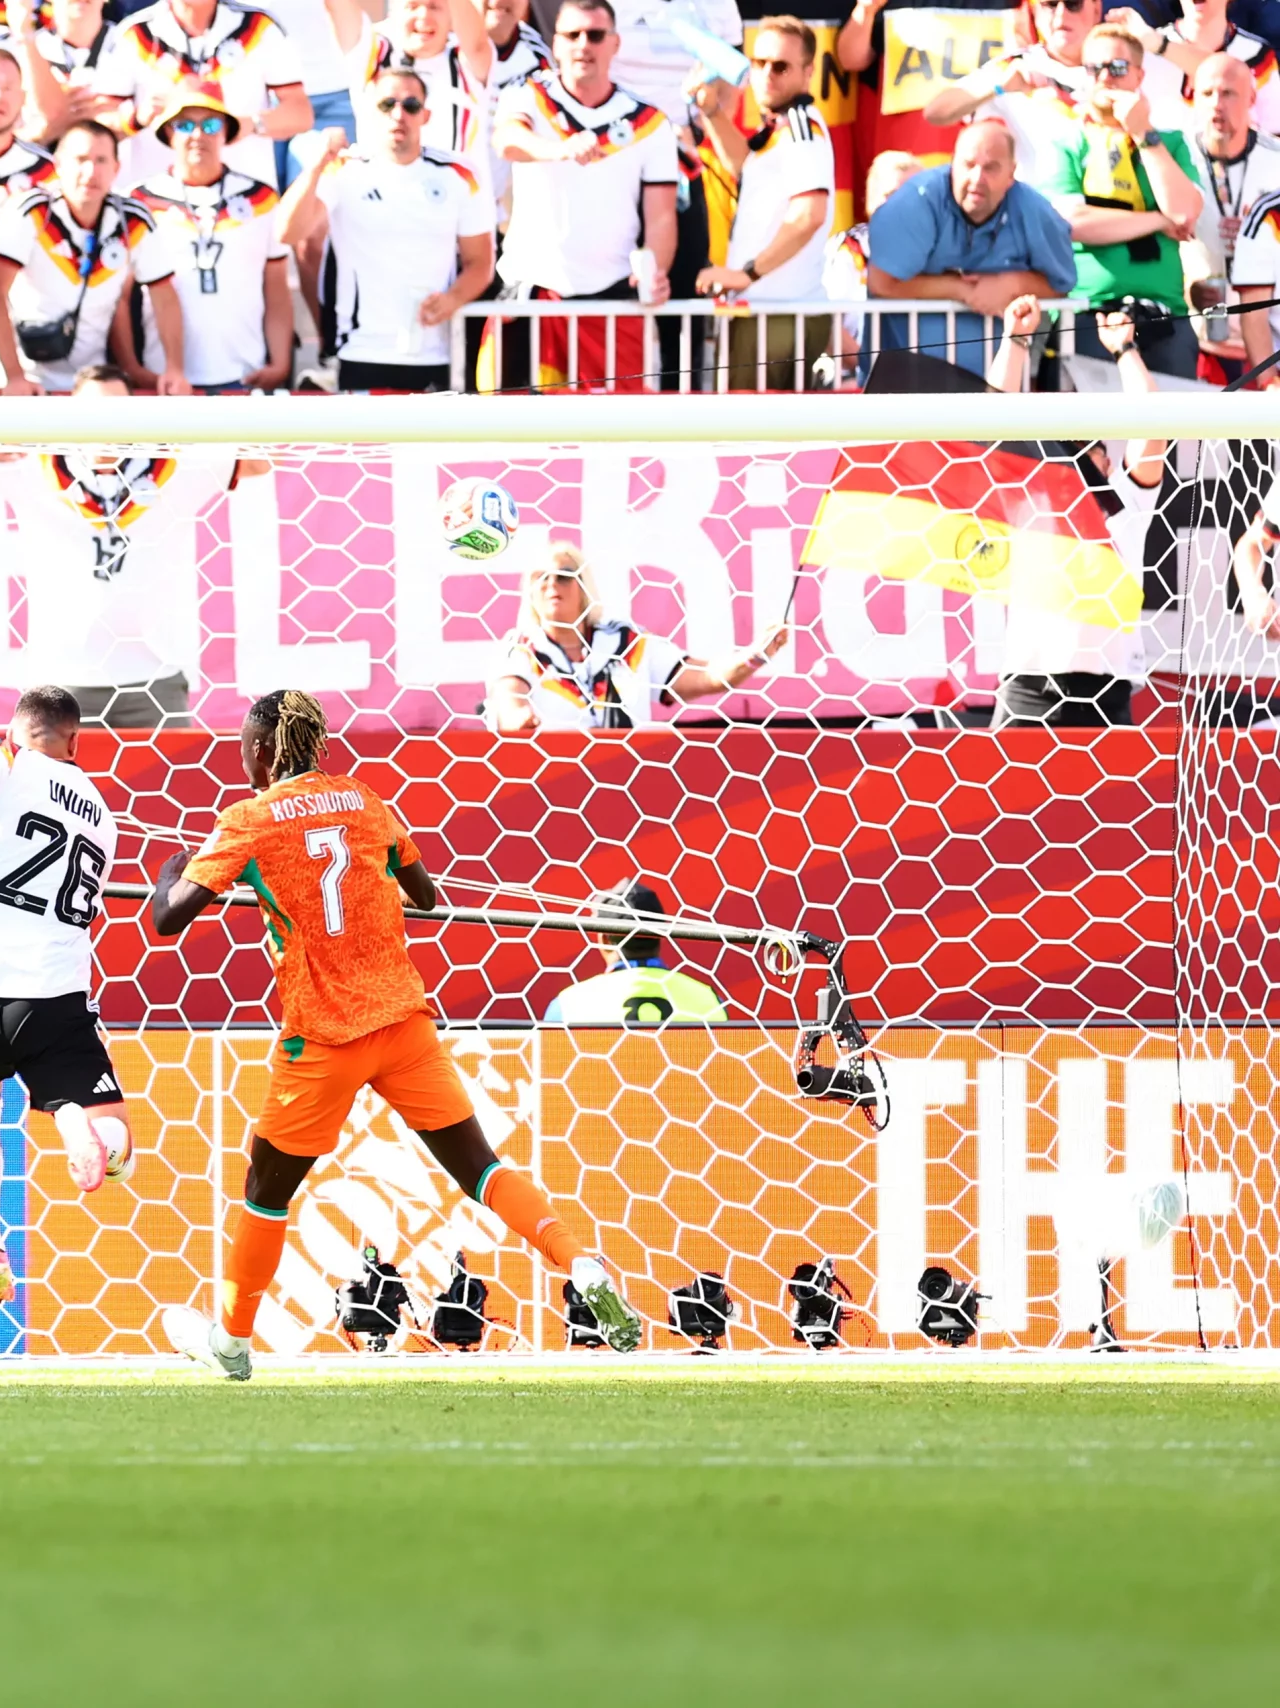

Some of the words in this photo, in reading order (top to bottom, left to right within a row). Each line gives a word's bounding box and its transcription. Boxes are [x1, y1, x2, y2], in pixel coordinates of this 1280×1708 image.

[269, 789, 365, 822] KOSSOUNOU
[304, 825, 351, 937] 7
[852, 1058, 1236, 1333] THE
